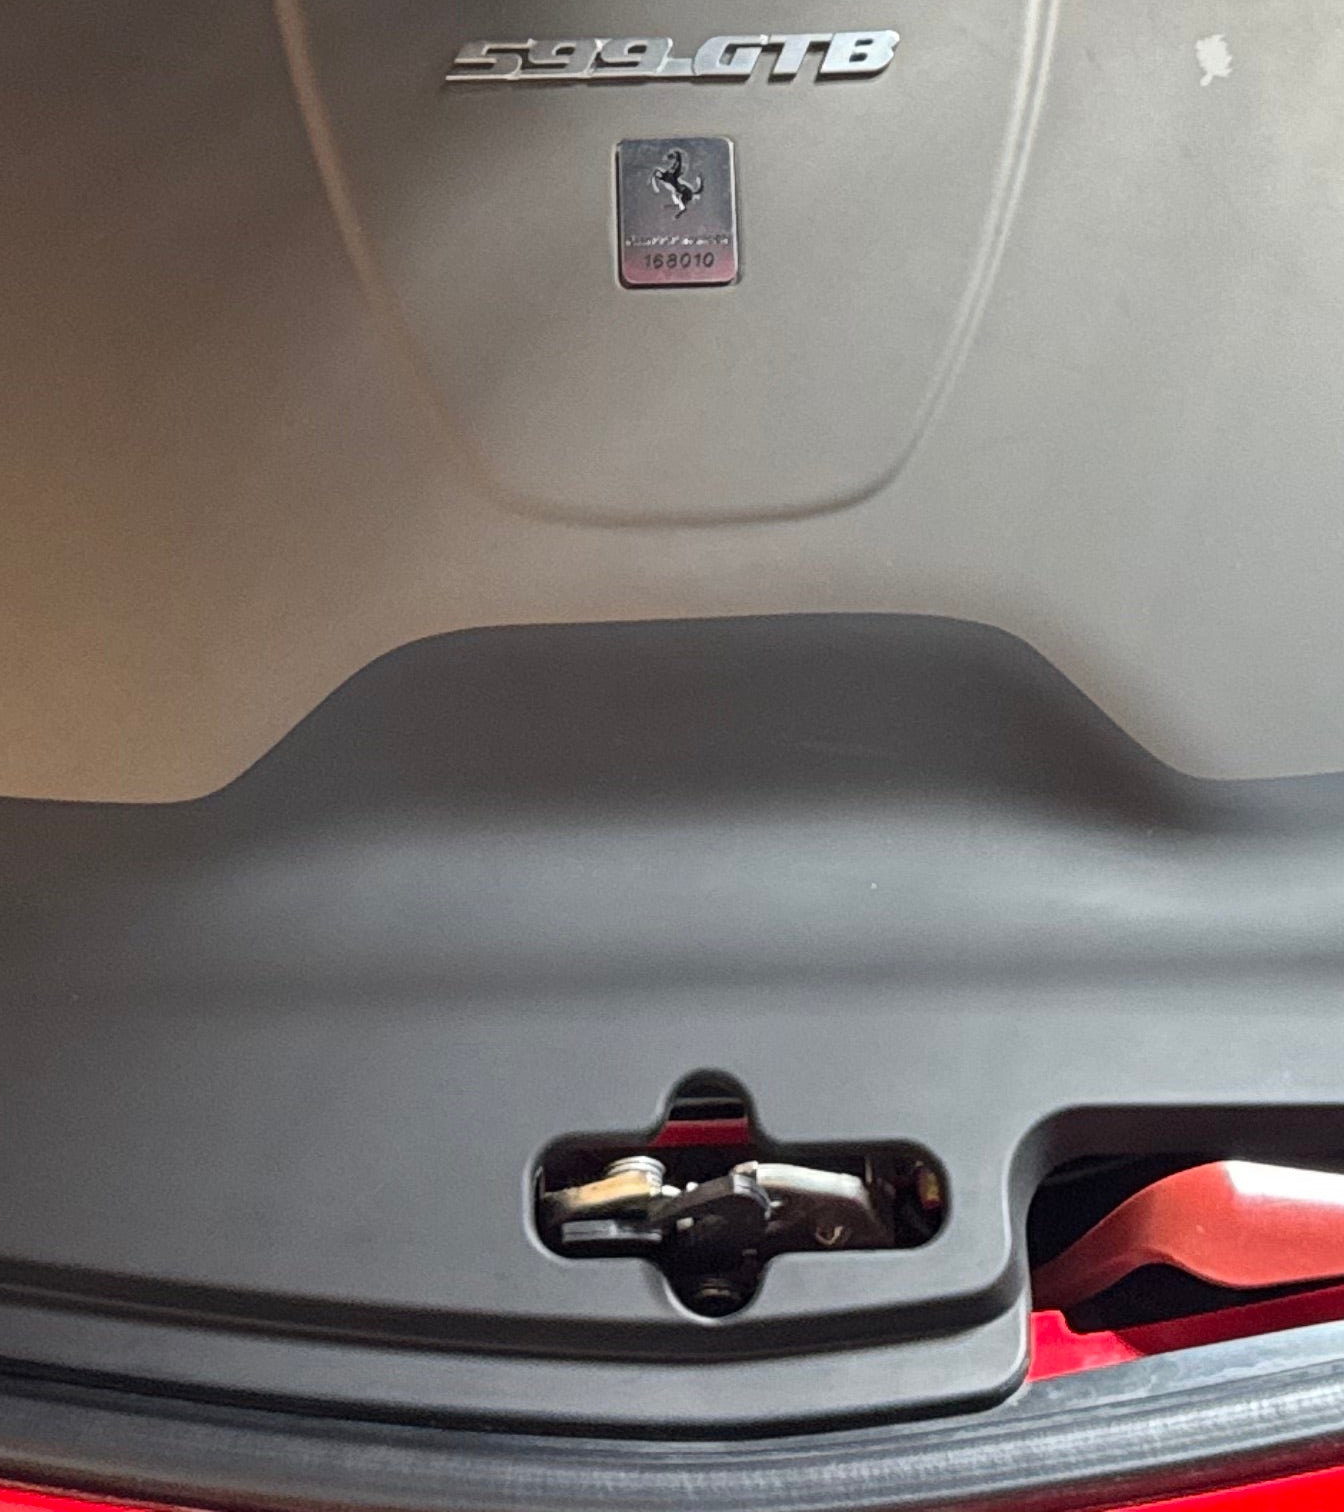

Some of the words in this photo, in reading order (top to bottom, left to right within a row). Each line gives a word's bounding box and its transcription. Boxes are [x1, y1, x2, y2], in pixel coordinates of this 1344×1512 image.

[445, 37, 674, 81] 599
[693, 29, 901, 86] GTB
[644, 252, 715, 269] 168010
